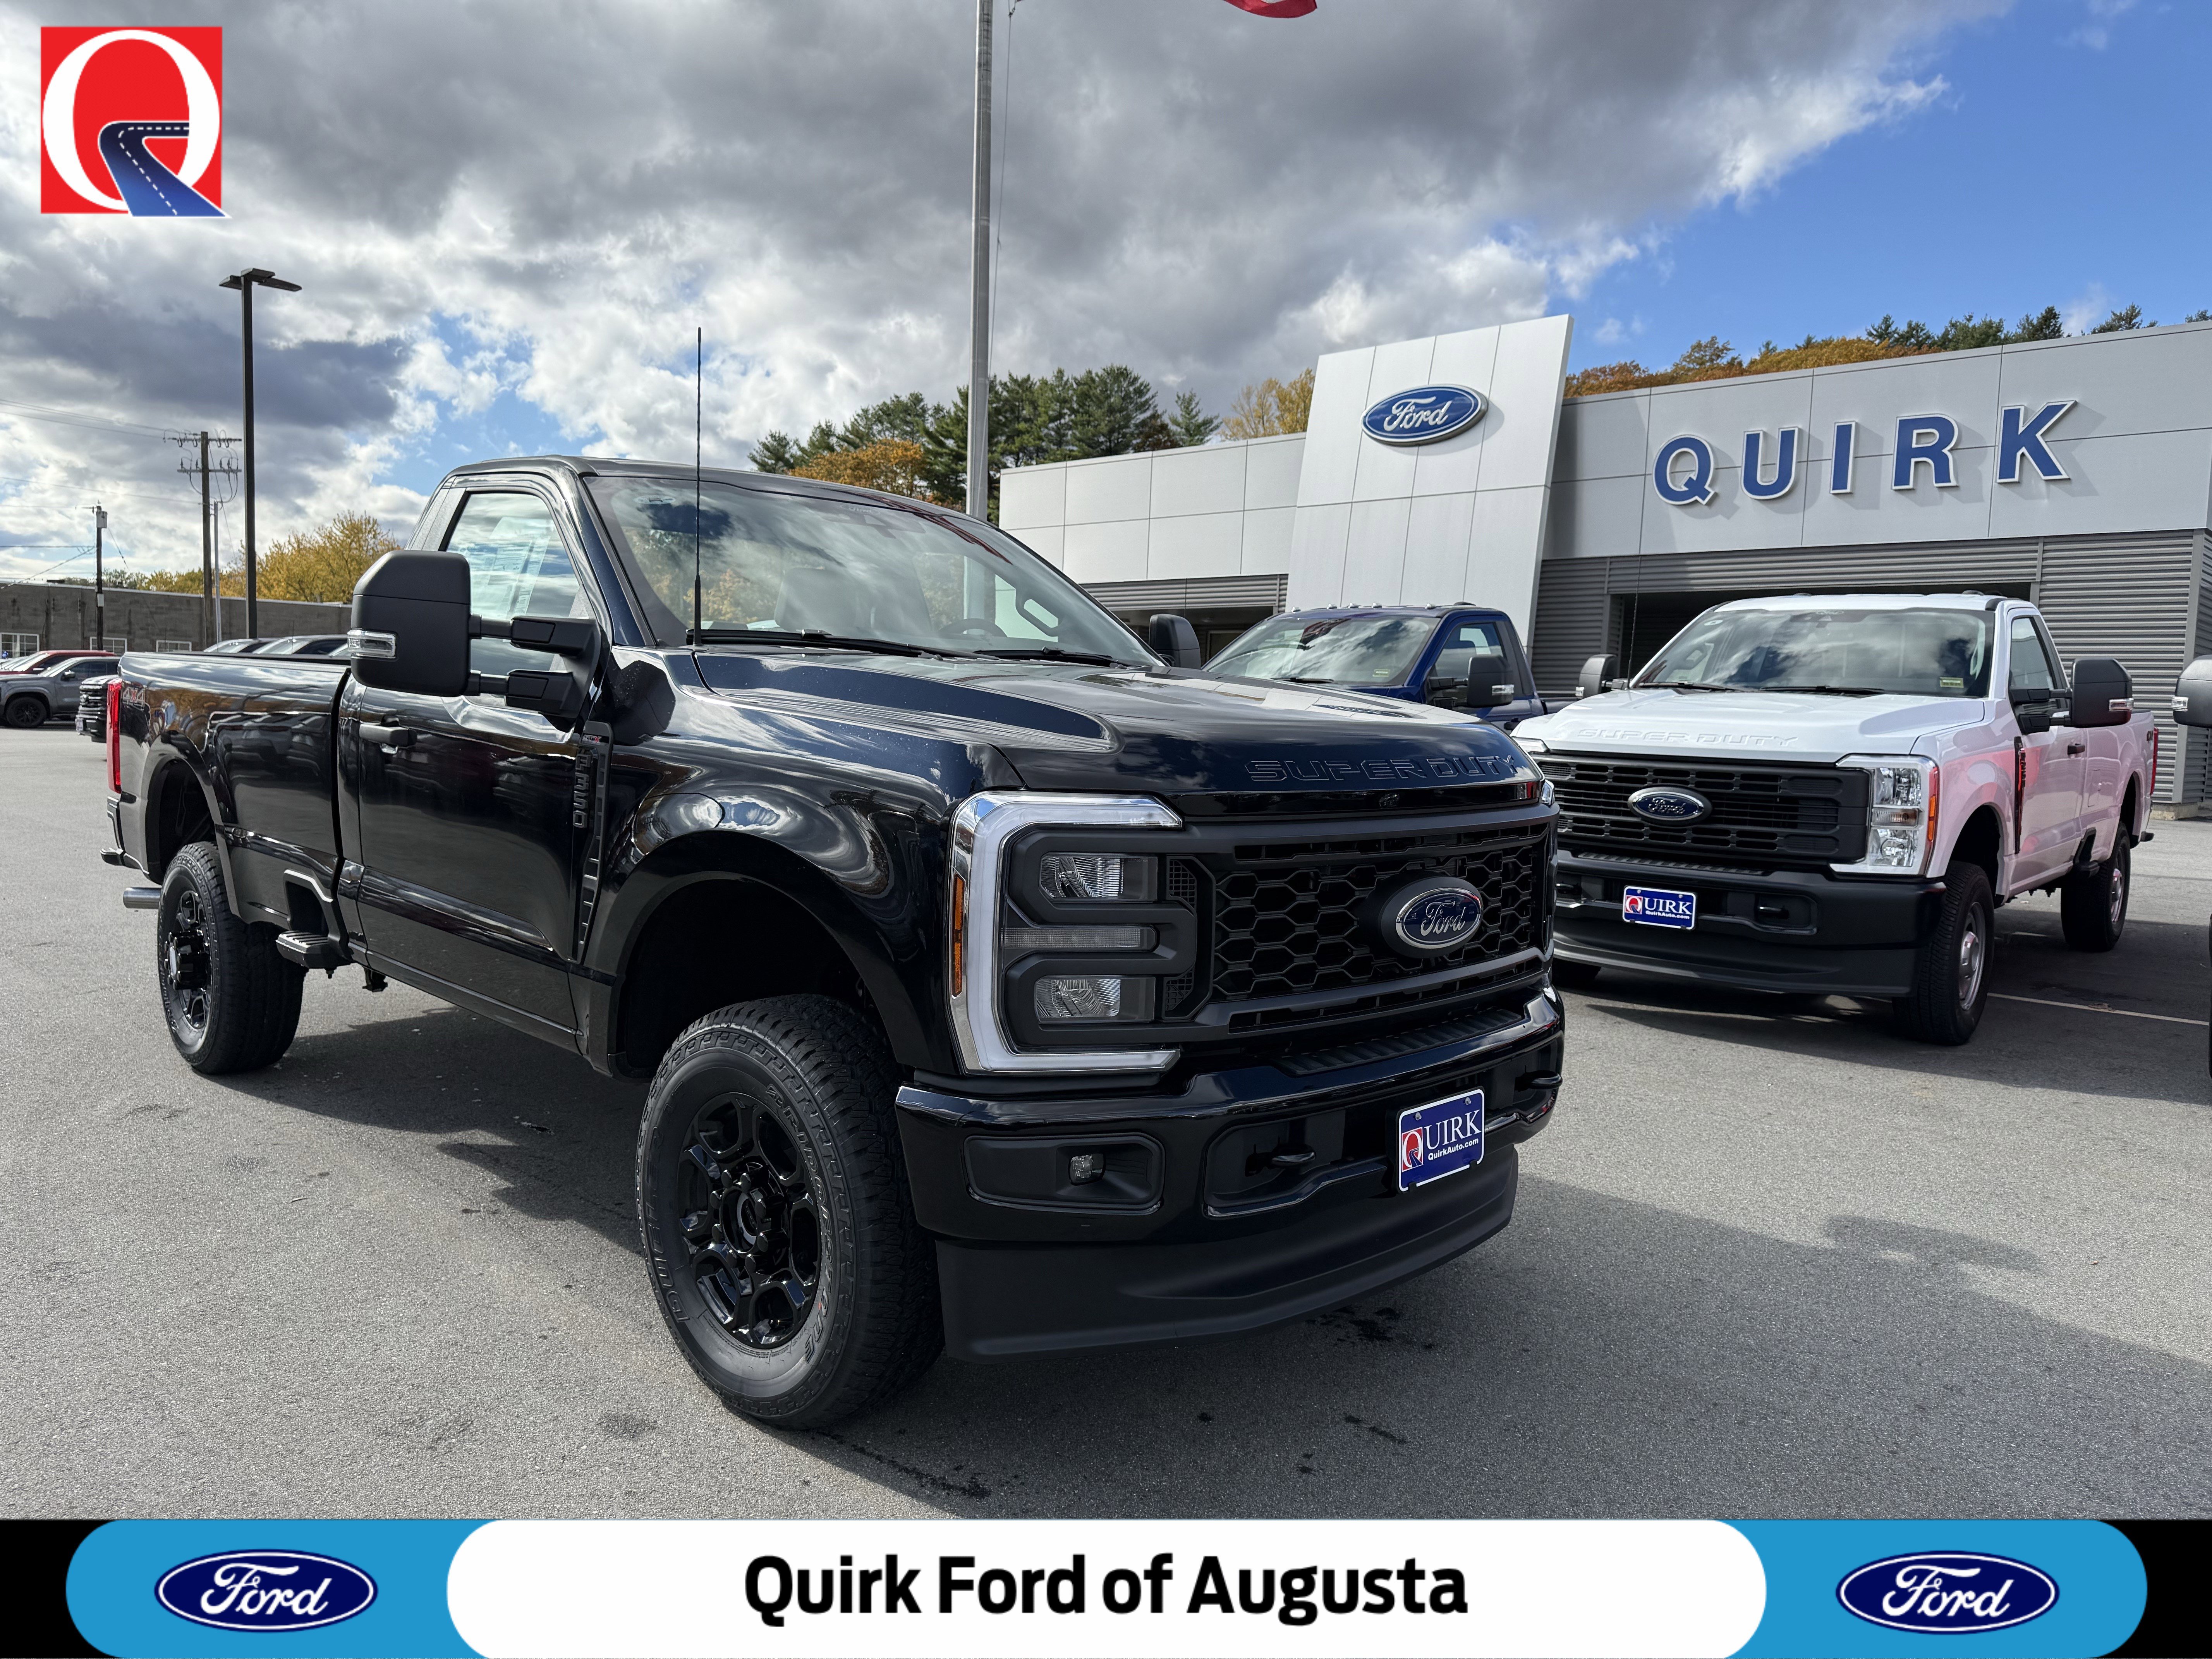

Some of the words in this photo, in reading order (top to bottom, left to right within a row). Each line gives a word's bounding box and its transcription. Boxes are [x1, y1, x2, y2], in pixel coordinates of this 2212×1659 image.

[1384, 396, 1452, 431] Ford
[1652, 399, 2077, 506] QUIRK
[1577, 728, 1689, 744] SUPER
[1696, 733, 1799, 747] DUTY
[1244, 759, 1428, 781] SUPER
[1426, 755, 1518, 778] DUTY
[1648, 797, 1687, 814] Ford
[1420, 900, 1467, 936] Ford
[1625, 896, 1692, 915] QUIRK
[1645, 910, 1690, 920] QuirkAuto.com
[1402, 1109, 1482, 1168] QUIRK
[1428, 1138, 1479, 1161] QuirkAuto.com
[764, 1082, 838, 1364] BRIDGESTONE
